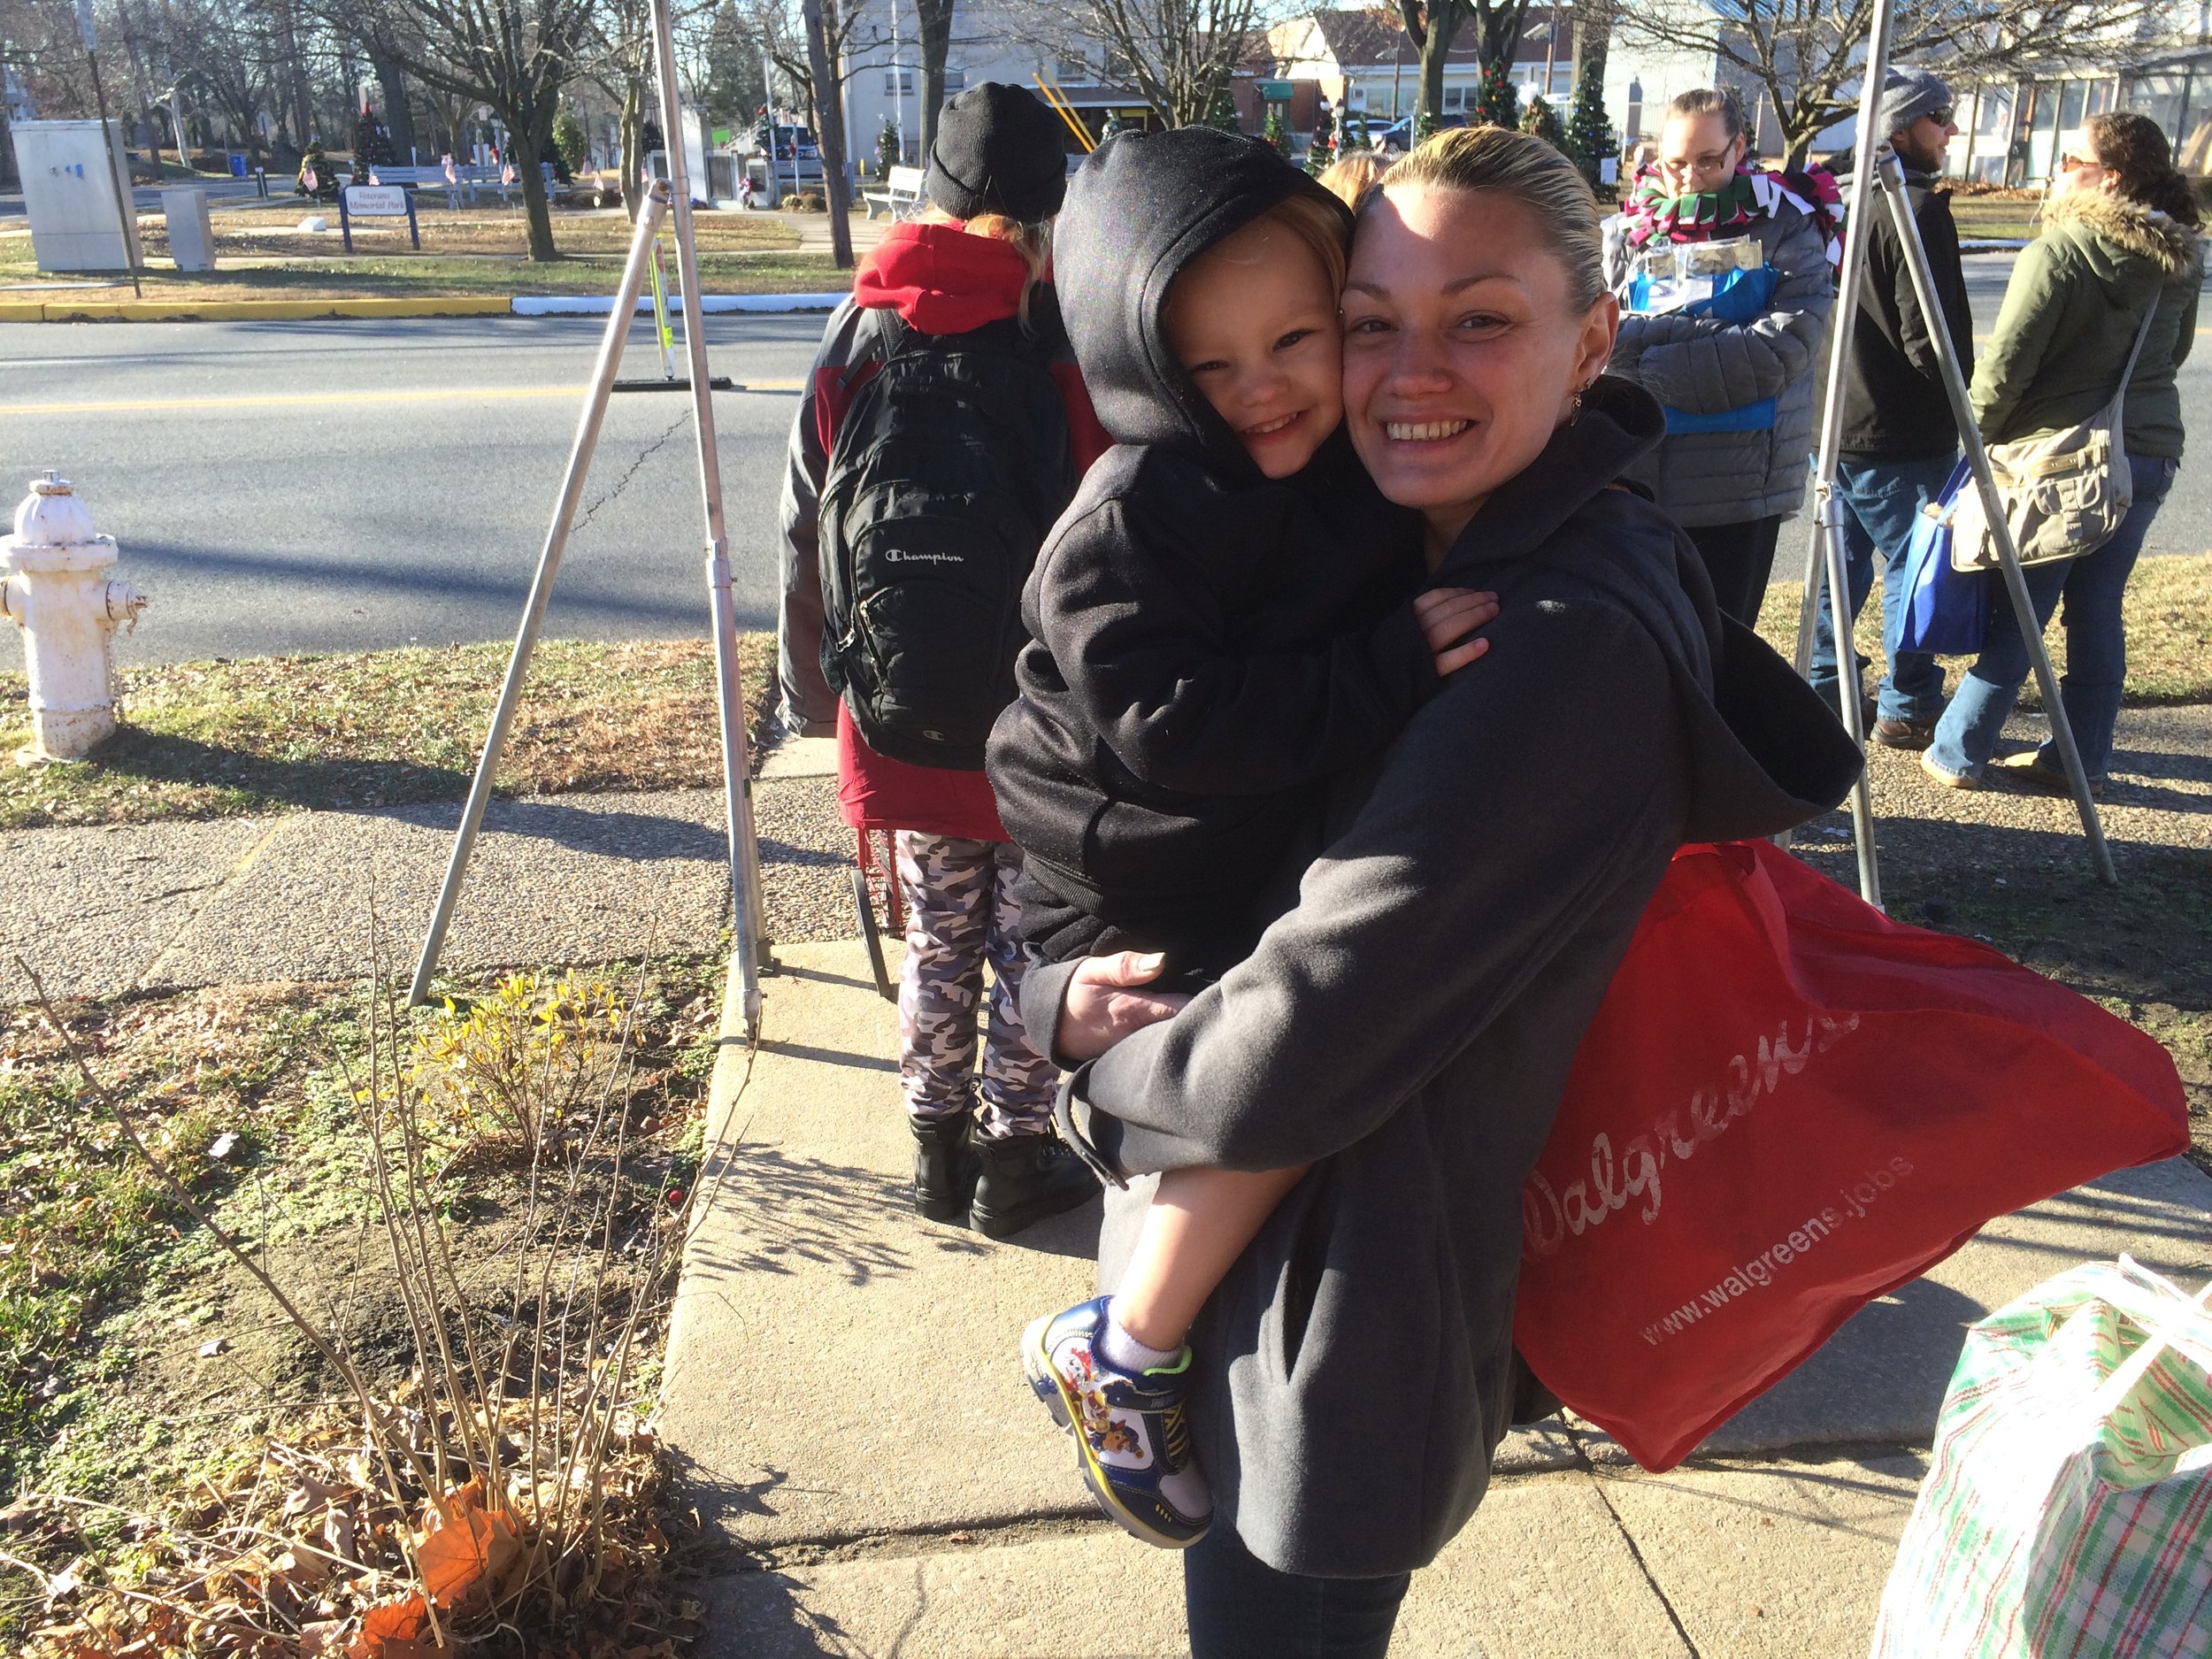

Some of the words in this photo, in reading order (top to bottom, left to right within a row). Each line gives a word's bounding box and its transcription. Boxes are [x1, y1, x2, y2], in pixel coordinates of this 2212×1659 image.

[349, 201, 385, 210] Memorial
[885, 549, 964, 565] Champion
[1640, 1156, 1915, 1346] www.walgreens.jobs
